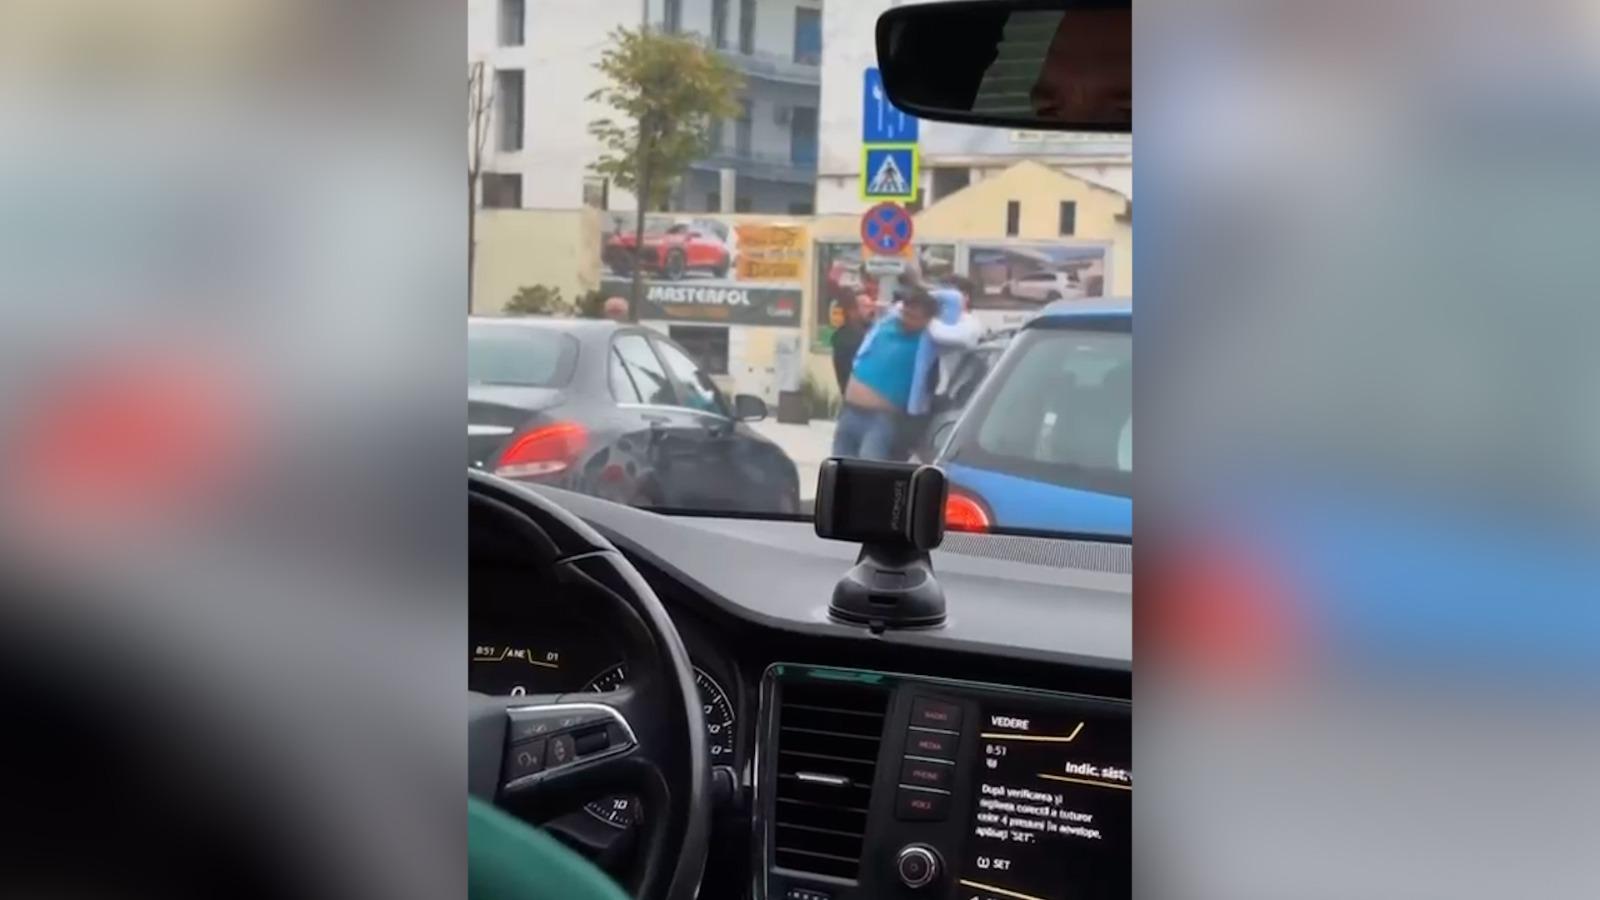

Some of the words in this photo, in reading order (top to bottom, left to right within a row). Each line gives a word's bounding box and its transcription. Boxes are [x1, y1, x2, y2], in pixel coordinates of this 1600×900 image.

[646, 286, 751, 305] MASTERFOL
[991, 715, 1030, 730] VEDERE
[985, 744, 1007, 756] 8:51
[1065, 761, 1099, 777] Indic.
[981, 784, 1006, 798] După
[1007, 787, 1053, 803] verificarea
[613, 799, 628, 809] 10
[1051, 808, 1058, 818] a
[1001, 815, 1008, 825] 4
[992, 858, 1011, 870] SET
